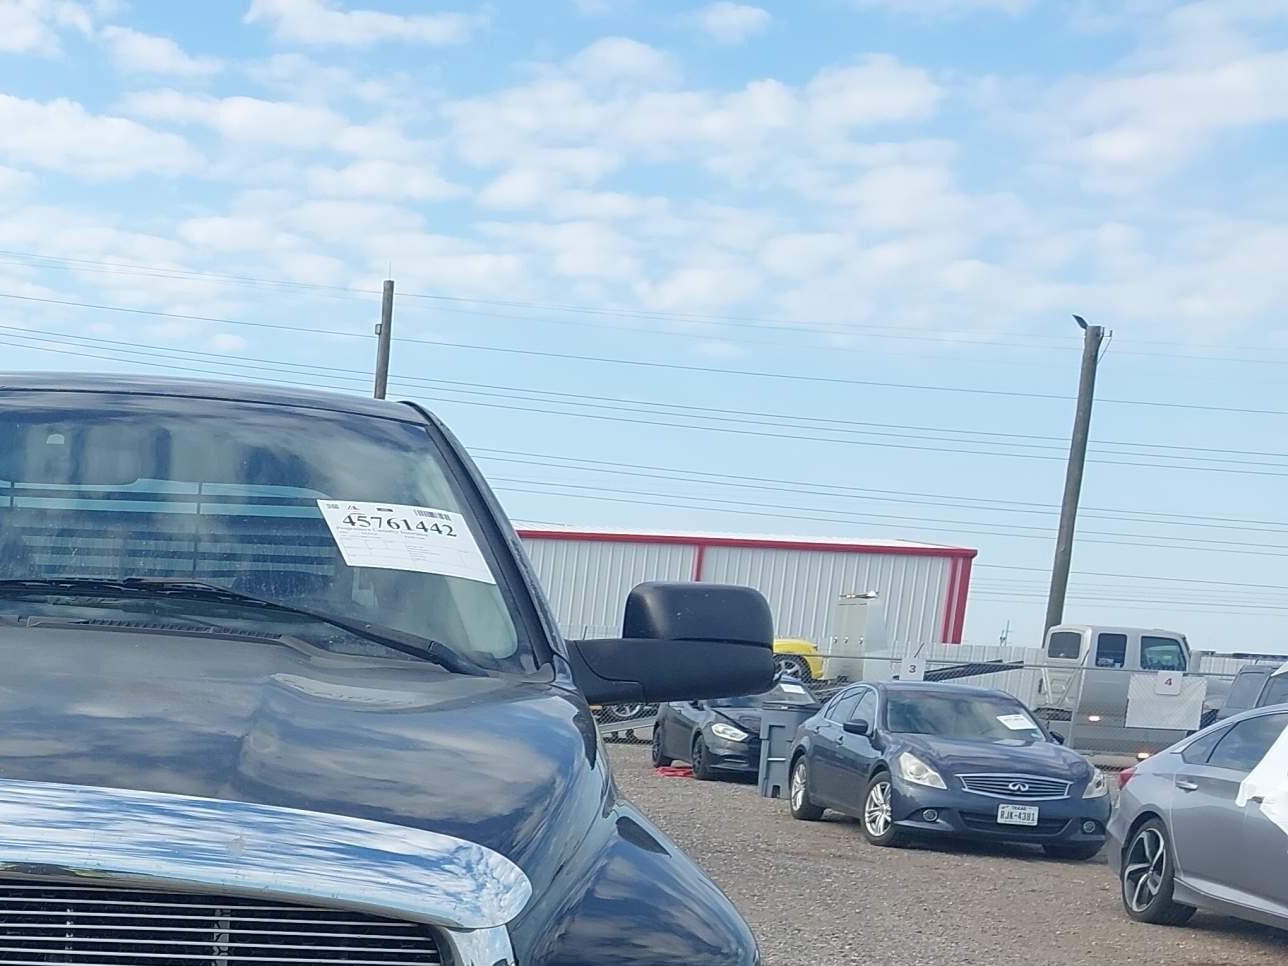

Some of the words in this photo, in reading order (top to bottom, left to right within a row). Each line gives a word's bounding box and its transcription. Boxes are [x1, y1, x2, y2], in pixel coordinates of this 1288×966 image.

[342, 514, 457, 537] 45761442
[908, 664, 917, 673] 3
[1164, 678, 1173, 686] 4
